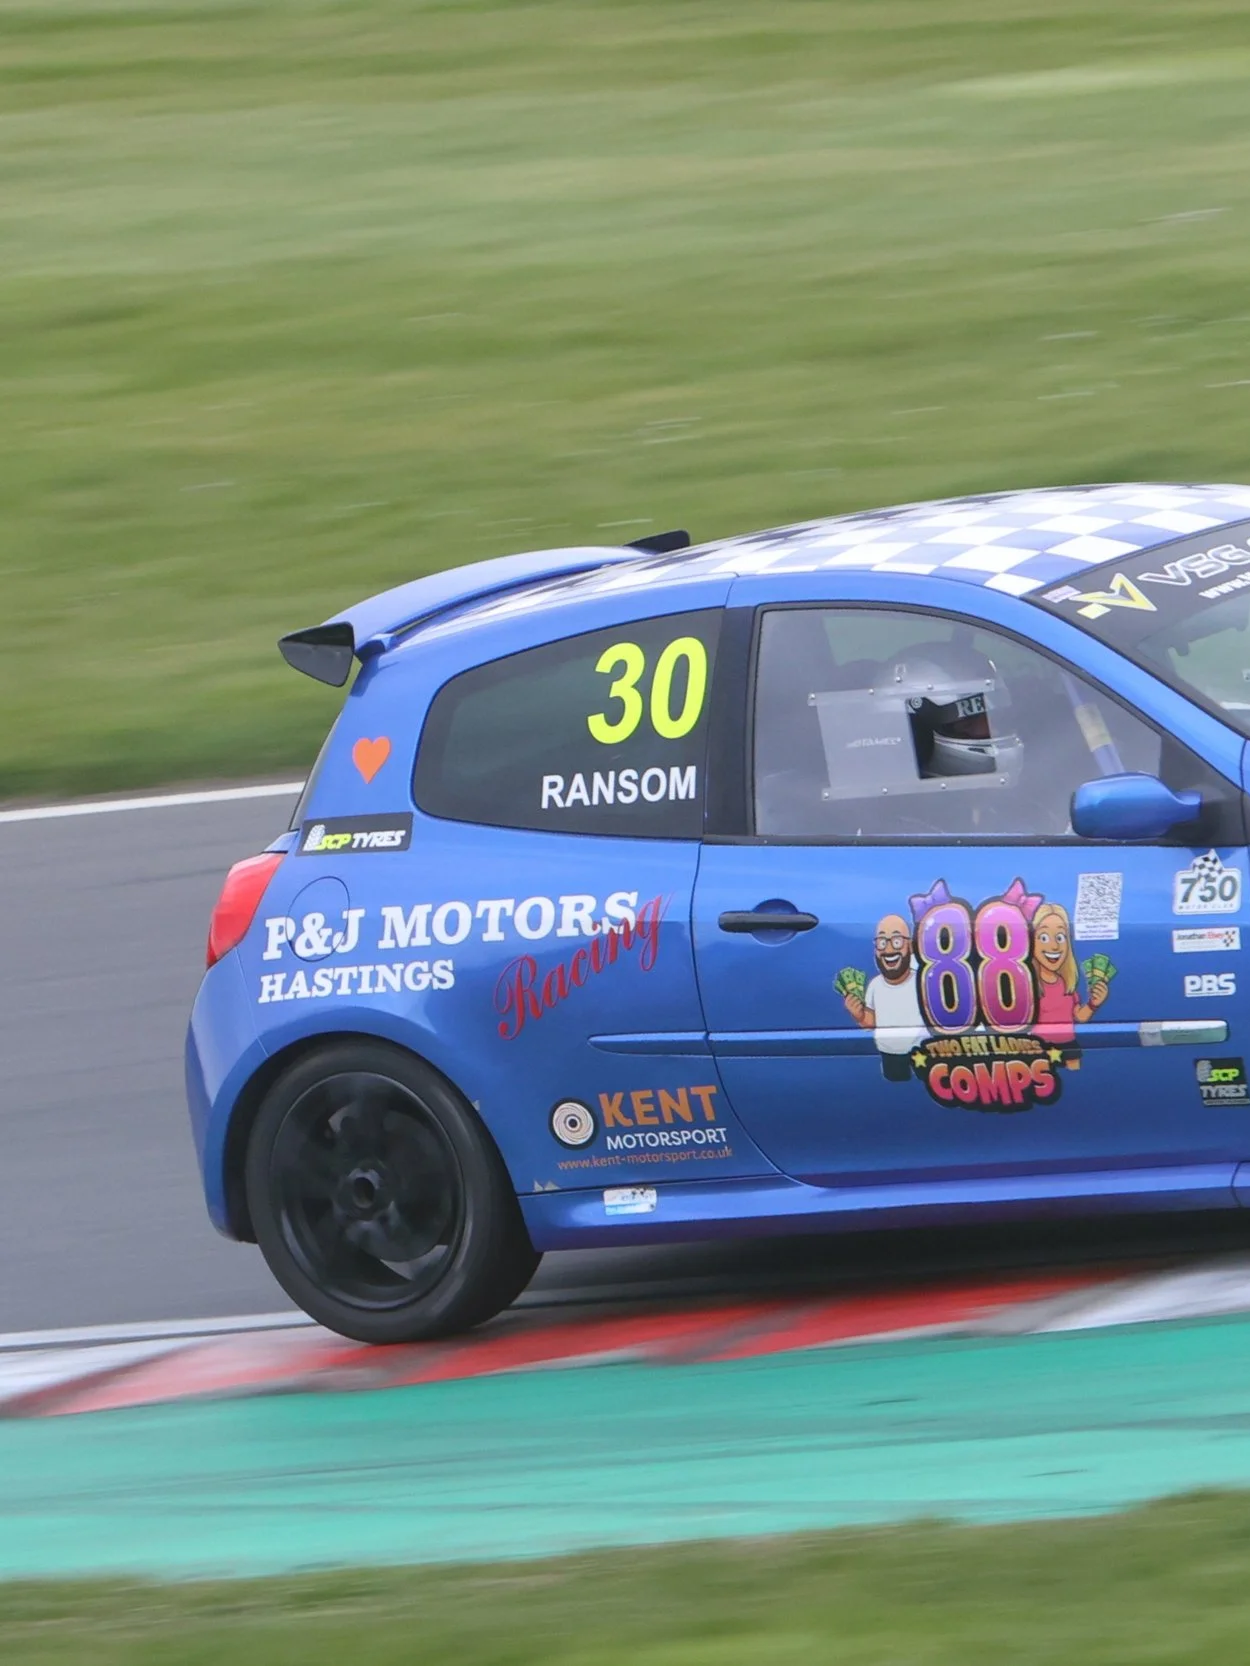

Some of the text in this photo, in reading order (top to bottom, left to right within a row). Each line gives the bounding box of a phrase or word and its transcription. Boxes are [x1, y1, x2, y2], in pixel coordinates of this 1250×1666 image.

[587, 636, 708, 744] 30
[541, 765, 697, 809] RANSOM
[314, 830, 406, 851] SCP TYRES
[1180, 875, 1238, 903] 750
[262, 891, 639, 960] P&J MOTORS
[258, 959, 455, 1004] HASTINGS
[493, 890, 675, 1040] Racing
[917, 902, 1038, 1034] 88
[926, 1038, 962, 1058] TWO
[961, 1035, 990, 1057] FAT
[928, 1058, 1056, 1105] COMPS
[1200, 1084, 1249, 1099] TYRES
[1207, 1068, 1240, 1083] SCP
[598, 1084, 718, 1128] KENT
[557, 1145, 734, 1171] www.kent-motorsport.co.uk
[606, 1127, 729, 1150] MOTORSPORT
